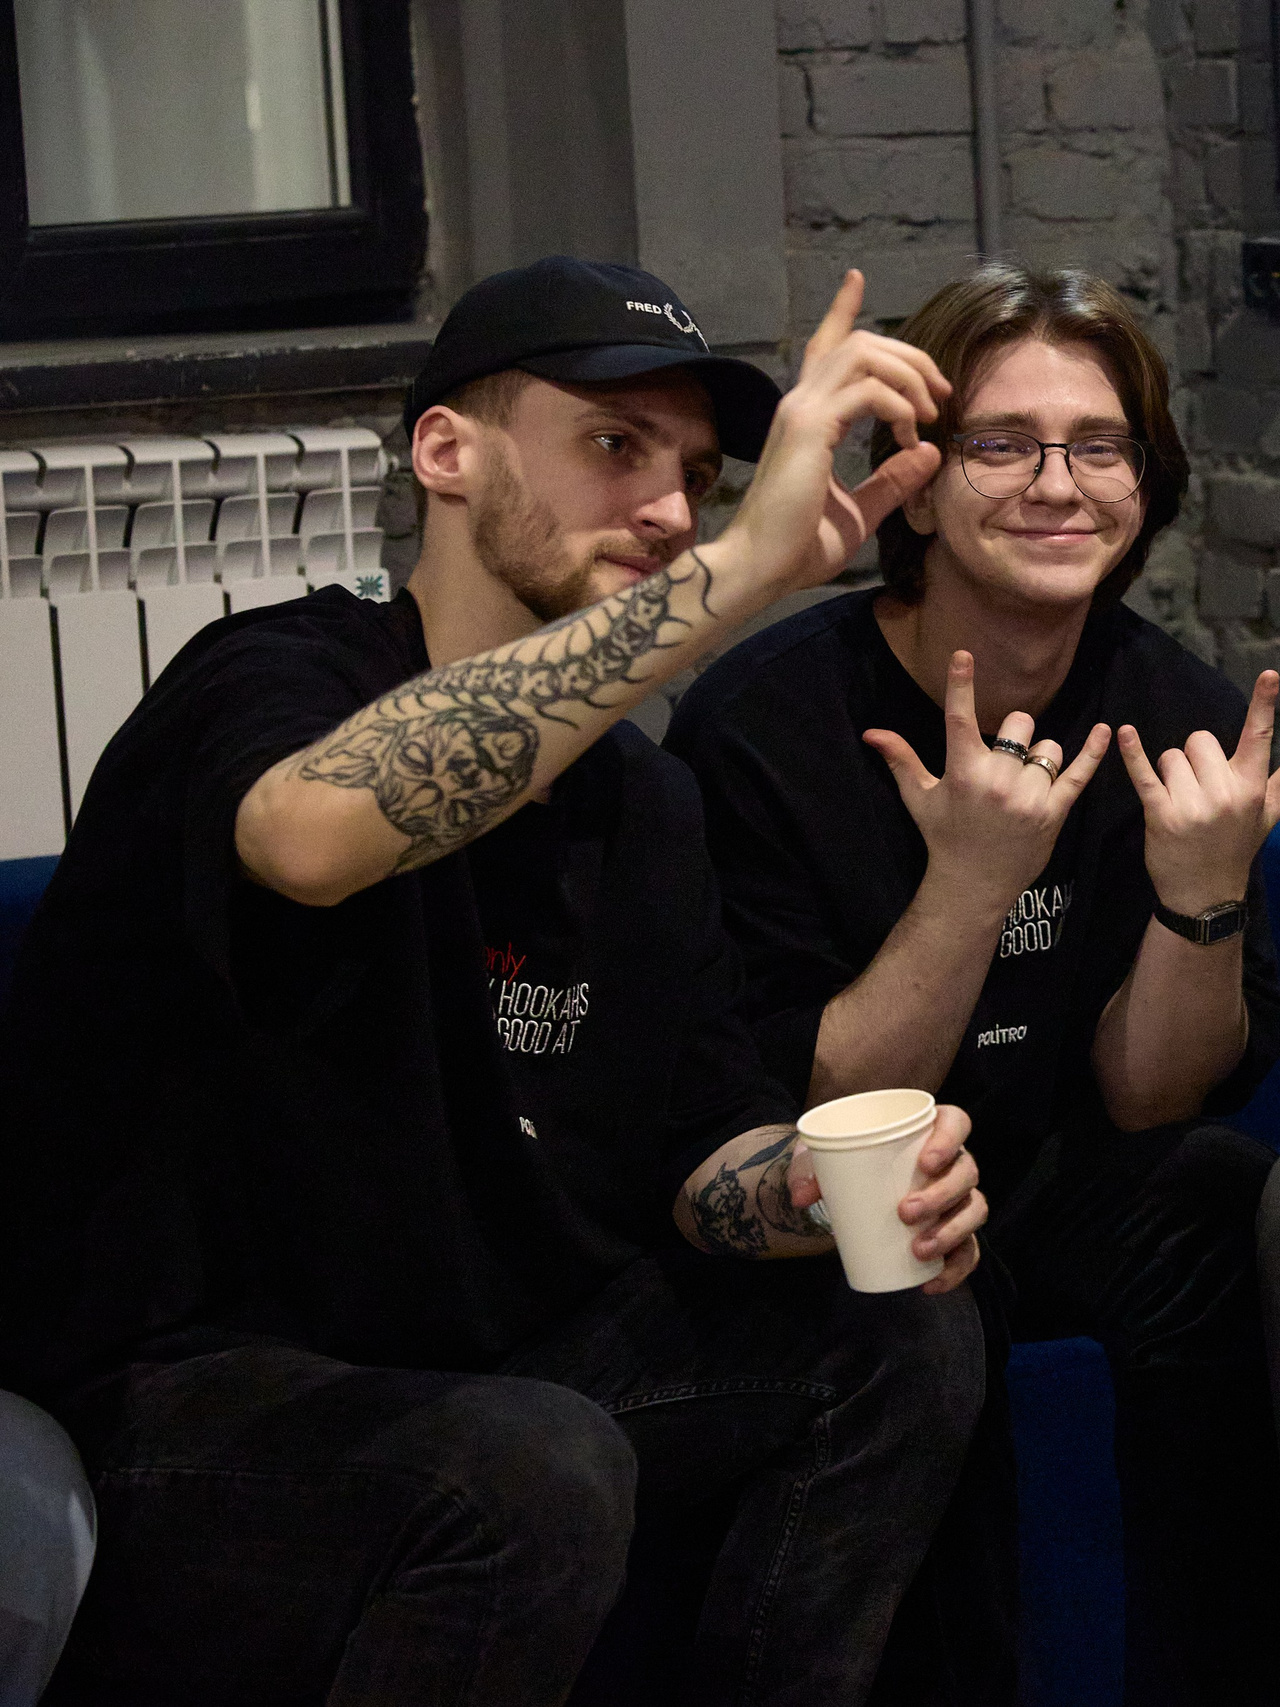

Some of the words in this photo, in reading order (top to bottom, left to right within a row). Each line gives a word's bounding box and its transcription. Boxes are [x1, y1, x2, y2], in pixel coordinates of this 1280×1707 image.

[626, 300, 662, 315] FRED
[1000, 919, 1051, 958] GOOD
[499, 980, 590, 1021] HOOKAHS
[497, 1017, 552, 1054] GOOD
[551, 1019, 581, 1054] AT
